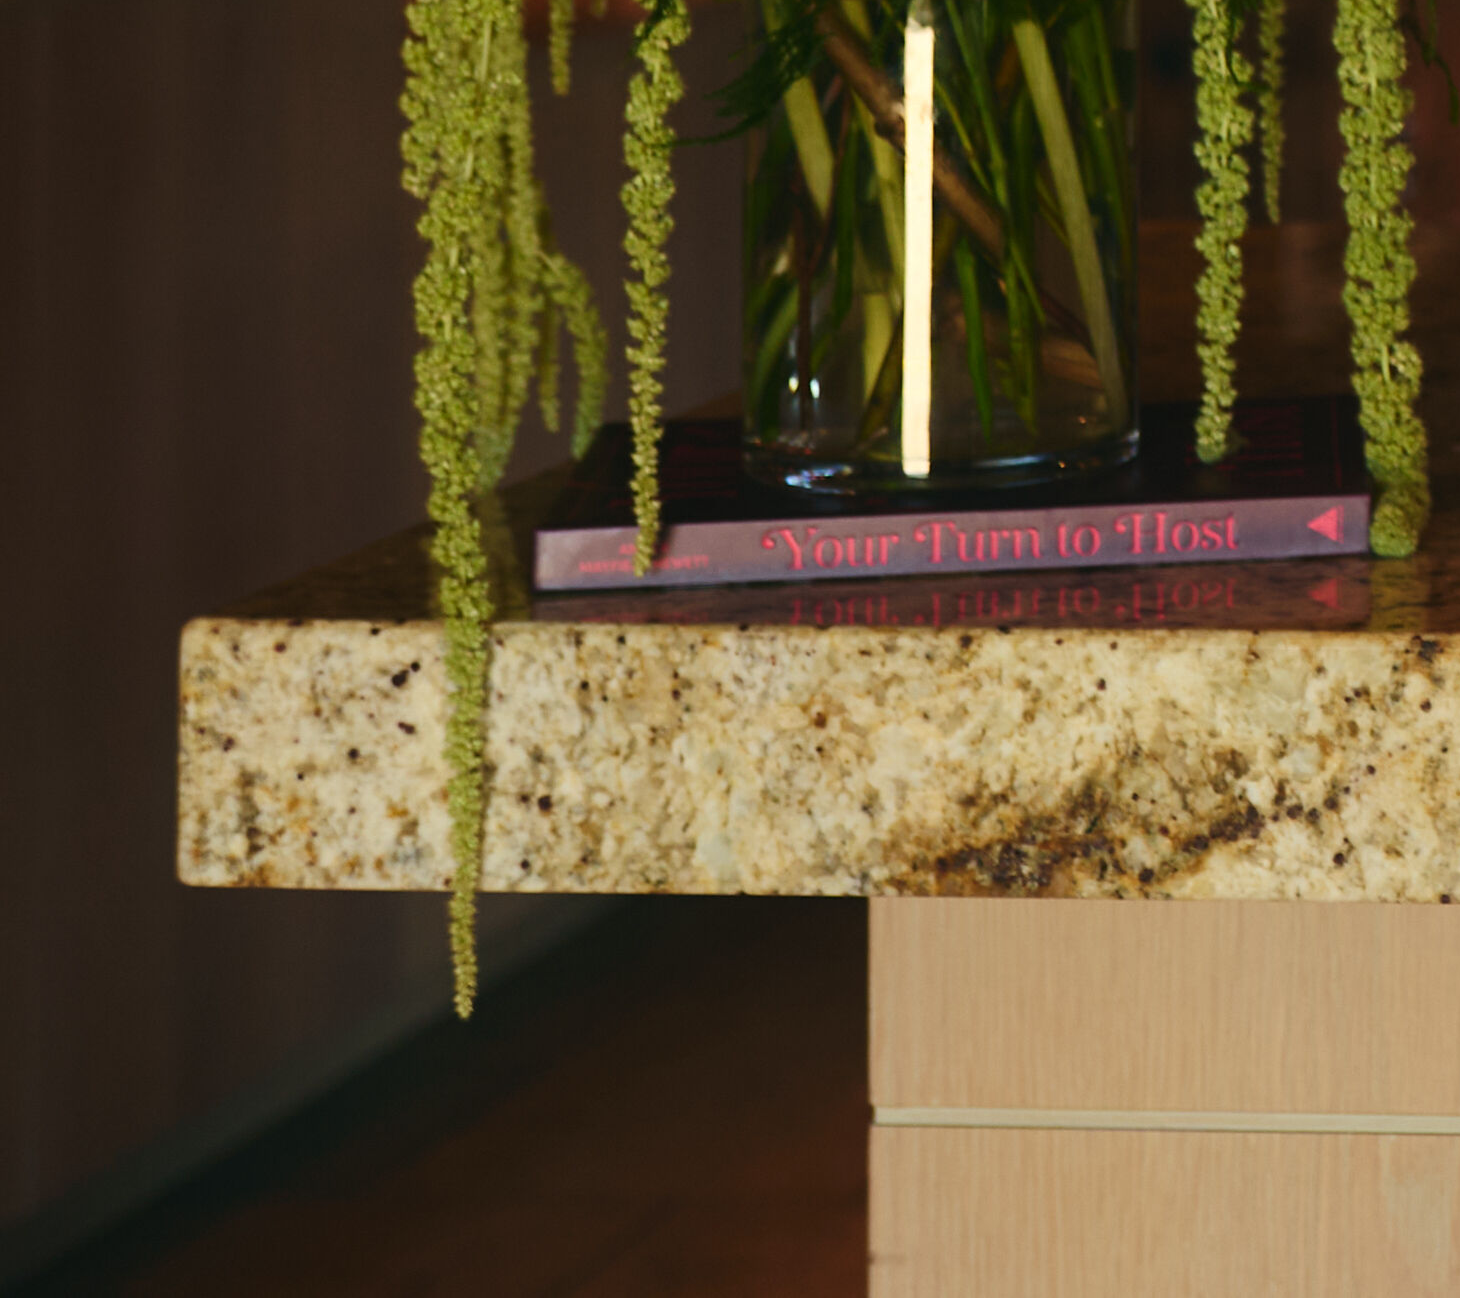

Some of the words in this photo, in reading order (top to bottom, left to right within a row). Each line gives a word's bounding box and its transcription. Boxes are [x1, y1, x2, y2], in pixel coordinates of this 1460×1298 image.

[761, 525, 900, 571] Your
[913, 520, 1042, 564] Turn
[1057, 521, 1101, 558] to
[1113, 511, 1239, 555] Host
